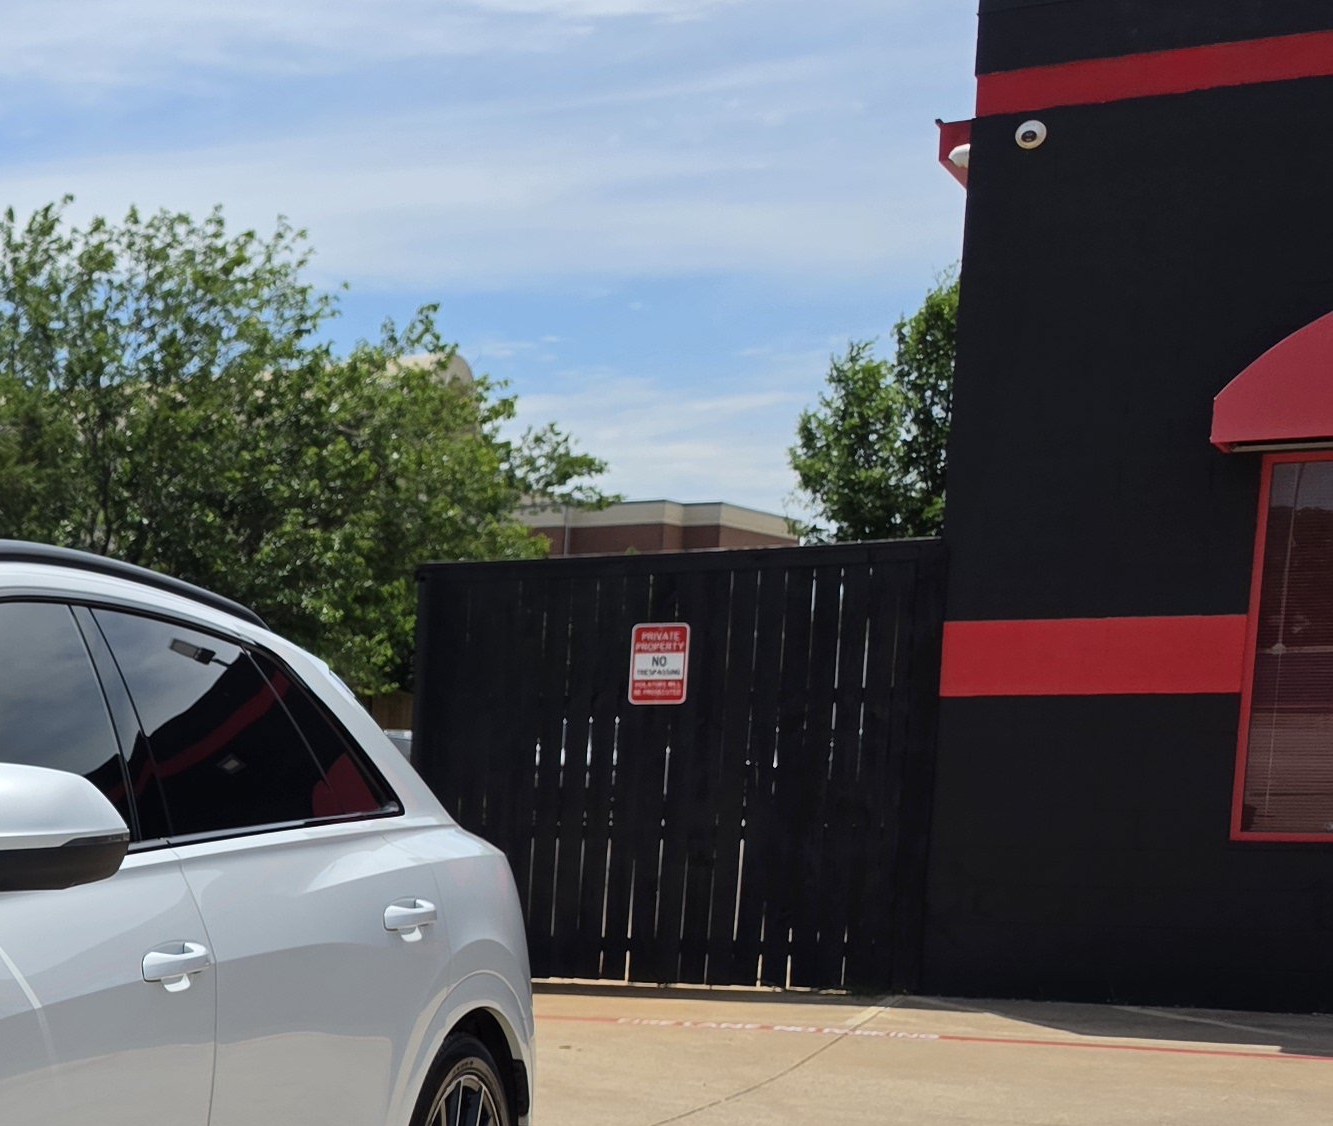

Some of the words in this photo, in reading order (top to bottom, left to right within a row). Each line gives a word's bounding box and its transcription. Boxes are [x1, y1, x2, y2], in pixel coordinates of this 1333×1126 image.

[641, 631, 681, 641] PRIVATE
[635, 641, 685, 652] PROPERTY
[652, 656, 667, 667] NO
